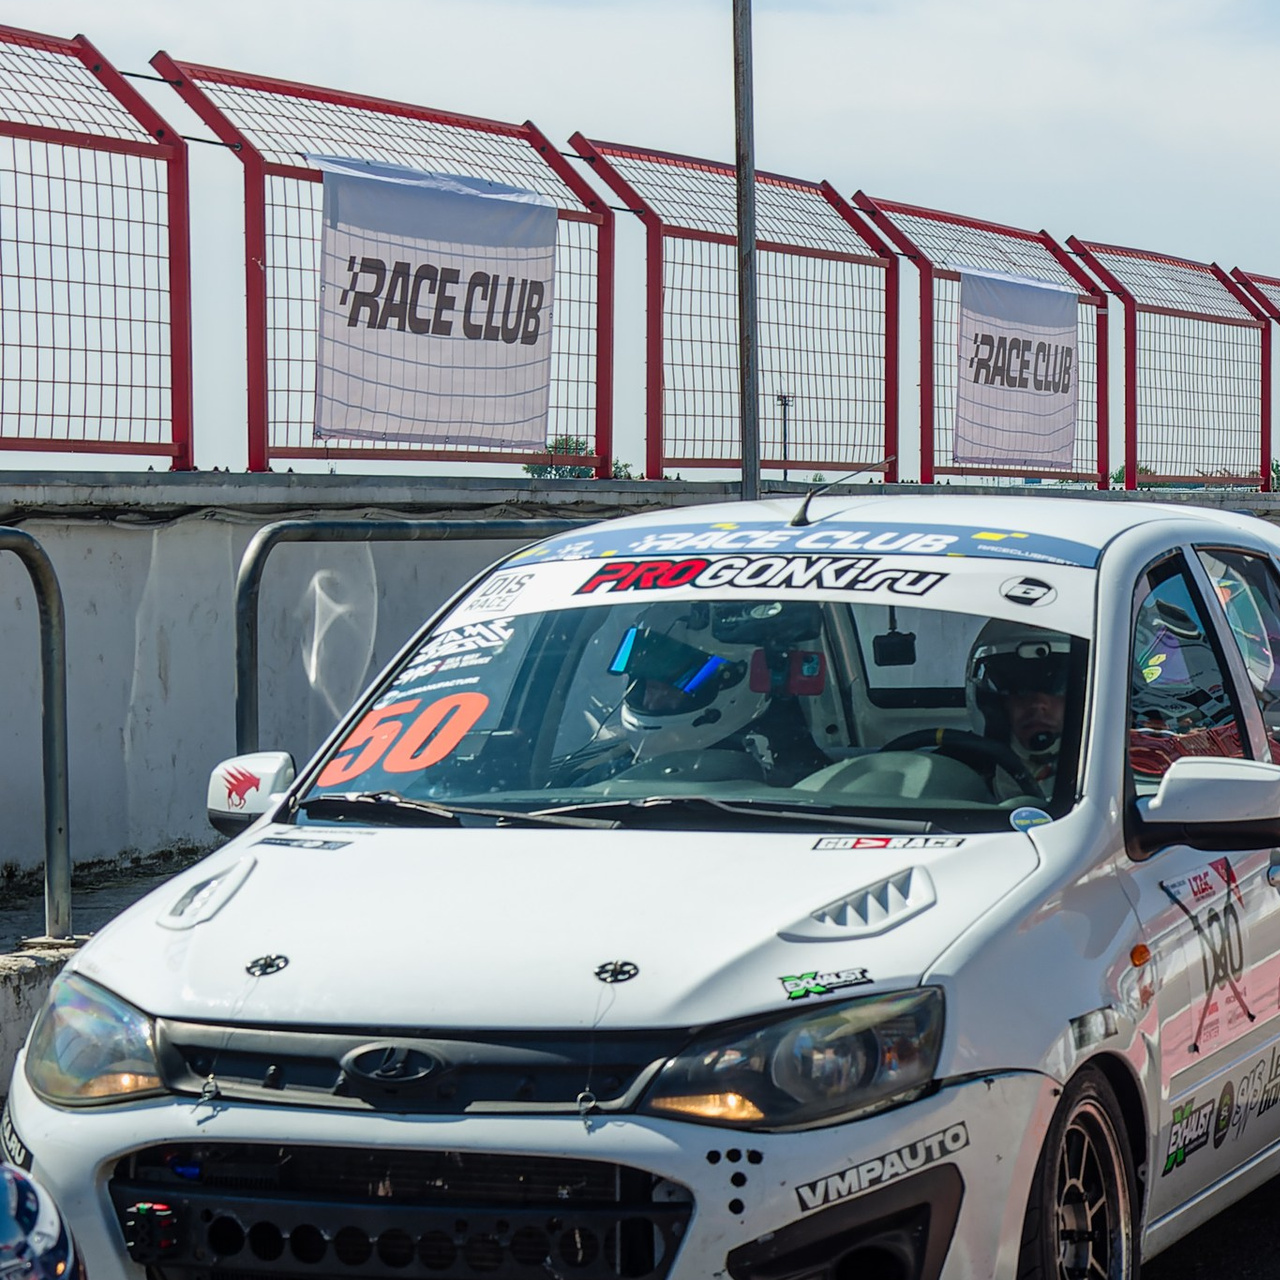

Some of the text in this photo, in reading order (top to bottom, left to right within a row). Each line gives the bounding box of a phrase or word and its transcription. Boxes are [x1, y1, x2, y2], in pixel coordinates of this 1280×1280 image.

[340, 256, 544, 345] RACE CLUB
[969, 333, 1072, 394] RACE CLUB
[630, 530, 959, 552] RACE CLUB
[464, 595, 515, 612] RACE
[316, 692, 490, 788] 50
[886, 838, 964, 849] RACE
[798, 1123, 968, 1209] VMPAUTO
